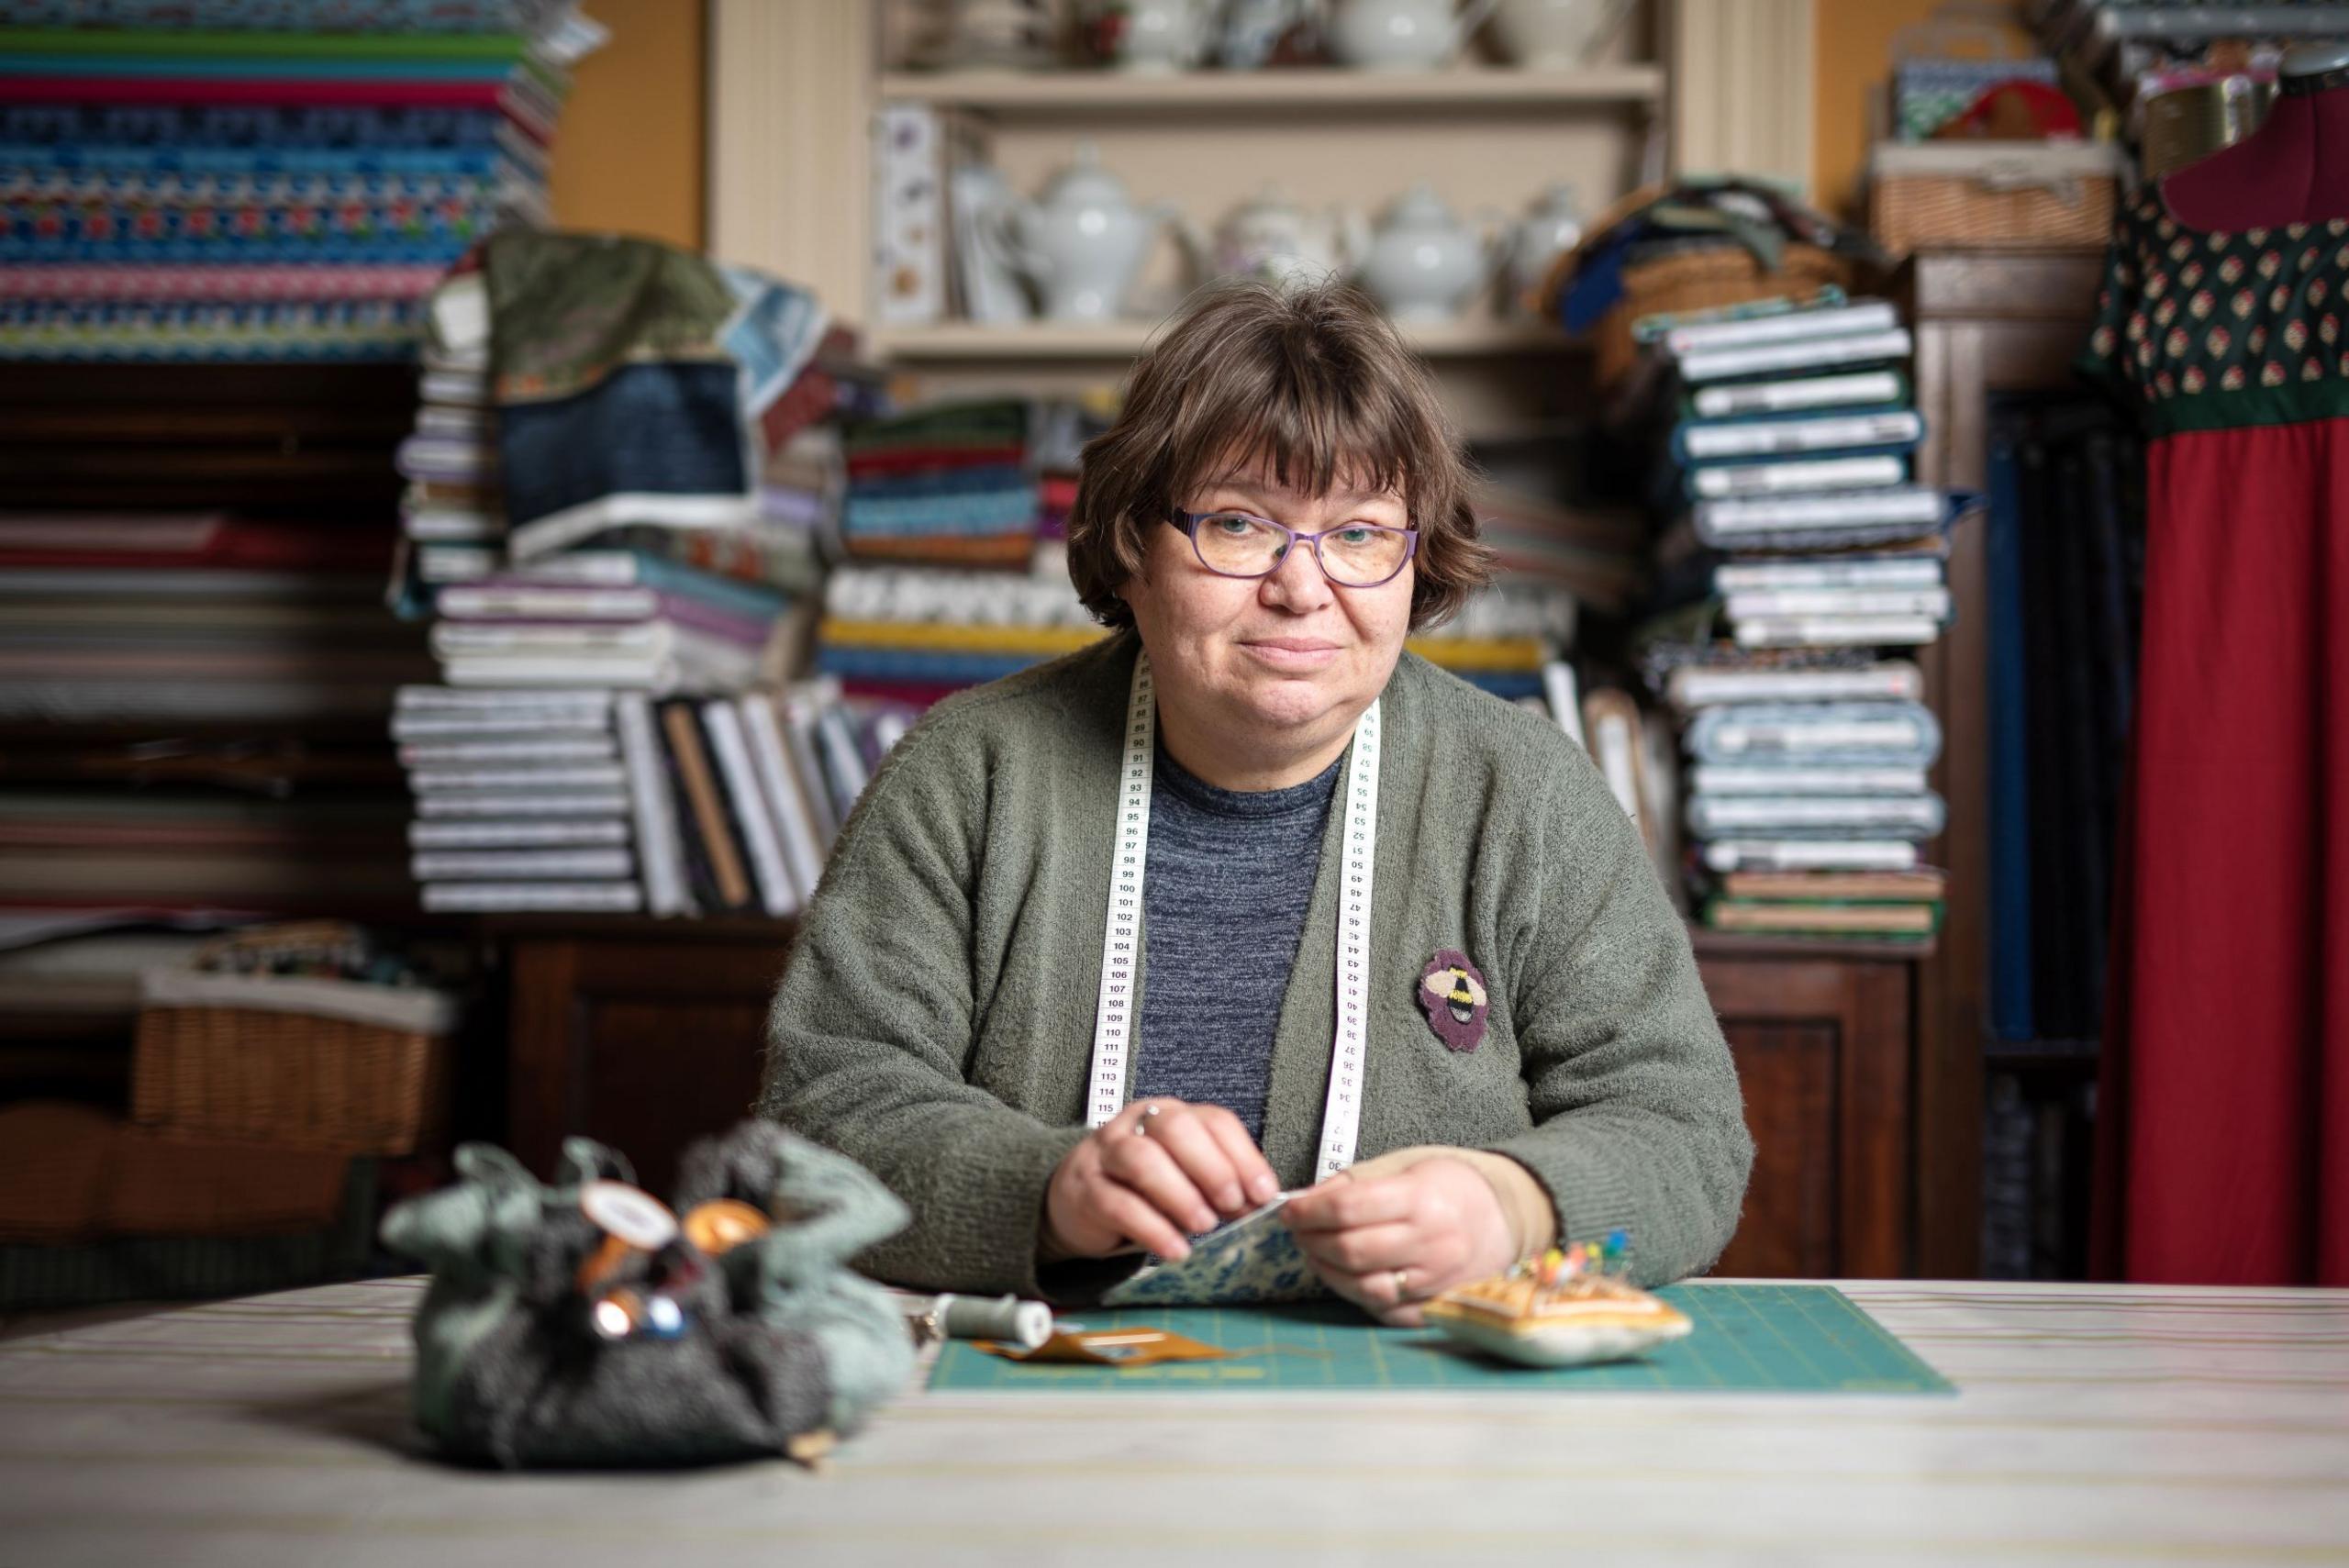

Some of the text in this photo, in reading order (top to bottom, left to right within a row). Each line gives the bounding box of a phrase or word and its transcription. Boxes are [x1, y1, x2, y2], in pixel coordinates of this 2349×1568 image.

[1134, 724, 1145, 732] 89
[1133, 739, 1144, 747] 90
[1362, 742, 1372, 752] 58
[1133, 754, 1143, 762] 91
[1360, 758, 1370, 768] 57
[1358, 773, 1369, 783] 56
[1130, 784, 1142, 792] 93
[1357, 787, 1367, 796] 55
[1129, 798, 1141, 806] 94
[1356, 803, 1366, 812] 54
[1354, 817, 1366, 826] 53
[1353, 832, 1364, 840] 52
[1125, 841, 1137, 850] 97
[1353, 847, 1364, 855] 51
[1119, 884, 1135, 893] 100
[1351, 889, 1362, 897] 48
[1119, 898, 1133, 906] 101
[1350, 904, 1361, 912] 47
[1117, 913, 1132, 921] 102
[1349, 917, 1360, 927] 46
[1115, 928, 1131, 936] 103
[1348, 932, 1360, 940] 45
[1114, 942, 1130, 951] 104
[1348, 946, 1360, 954] 44
[1112, 957, 1129, 965] 105
[1347, 960, 1359, 968] 43
[1111, 971, 1128, 979] 106
[1347, 973, 1359, 982] 42
[1347, 1002, 1357, 1011] 40
[1107, 1014, 1123, 1022] 109
[1347, 1016, 1357, 1026] 39
[1106, 1029, 1121, 1037] 110
[1347, 1030, 1357, 1040] 38
[1345, 1046, 1356, 1055] 37
[1102, 1058, 1119, 1066] 112
[1343, 1061, 1354, 1072] 36
[1341, 1077, 1353, 1086] 35
[1340, 1093, 1351, 1103] 34
[1332, 1143, 1343, 1153] 31
[1329, 1162, 1341, 1172] 30
